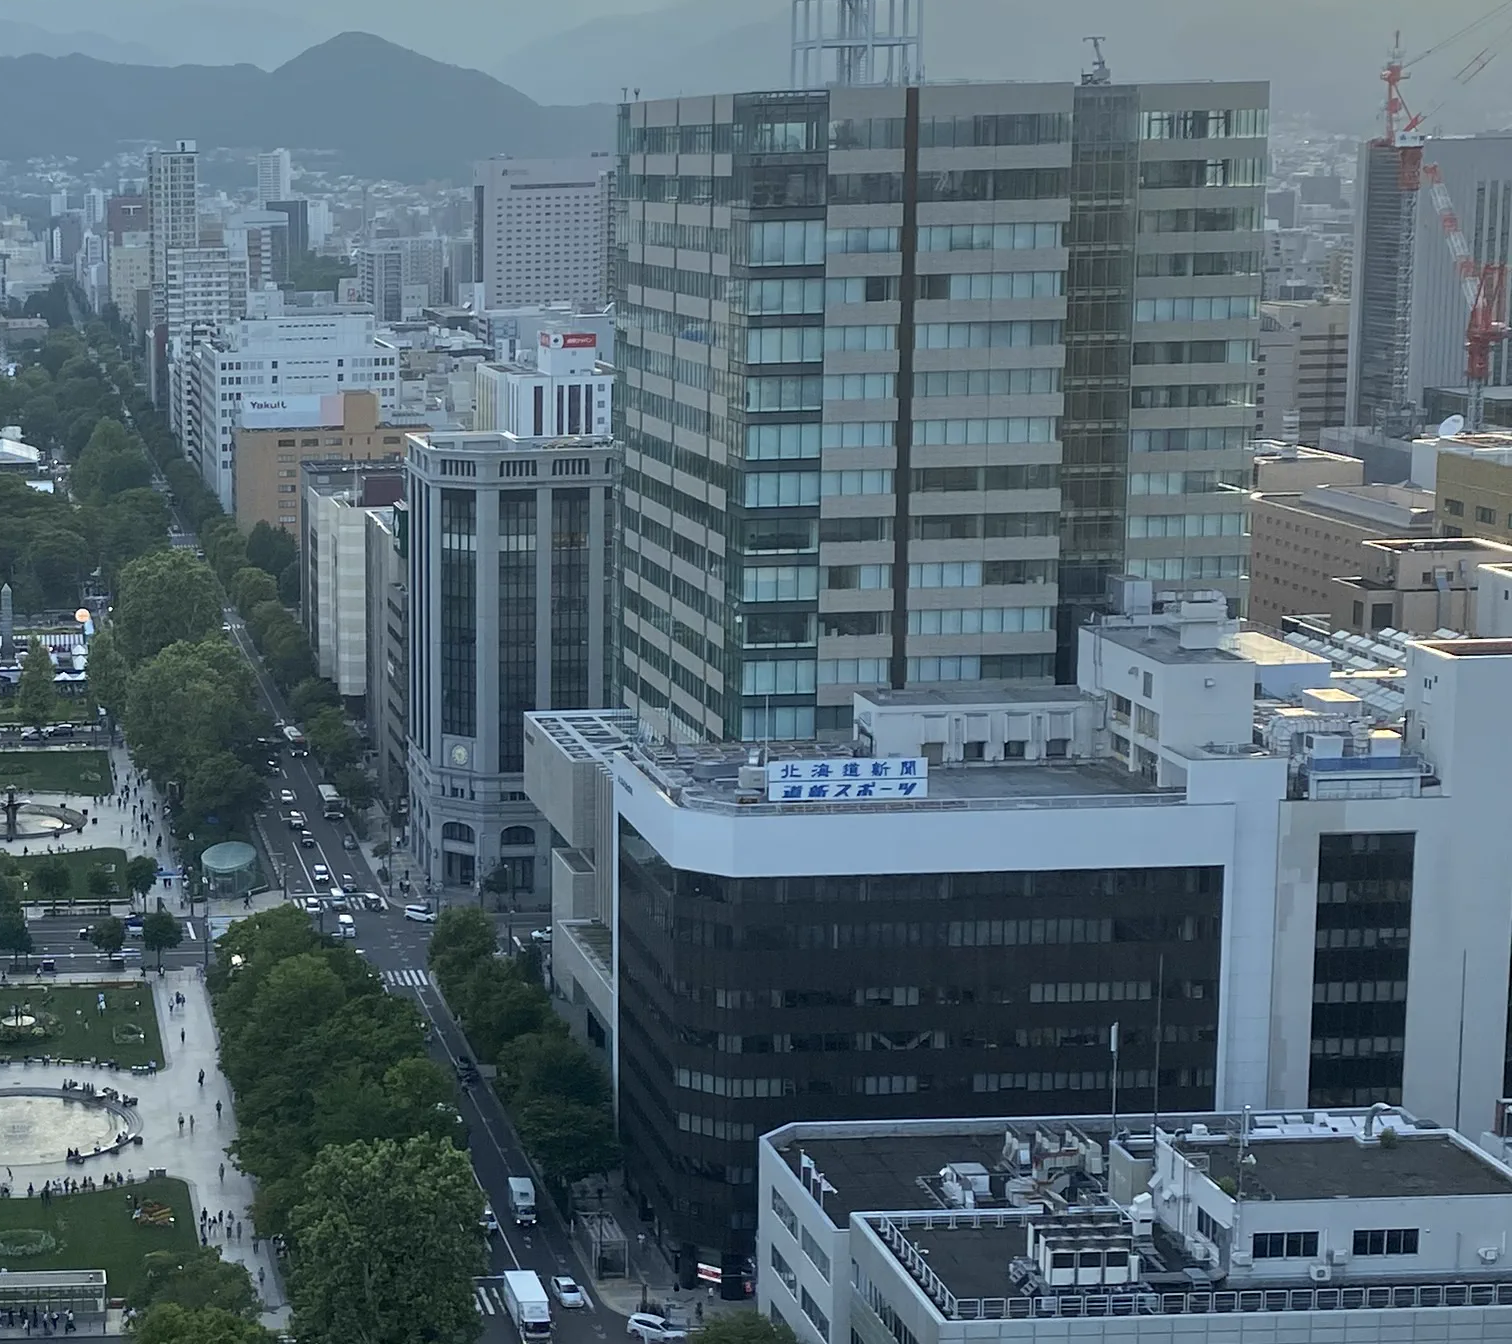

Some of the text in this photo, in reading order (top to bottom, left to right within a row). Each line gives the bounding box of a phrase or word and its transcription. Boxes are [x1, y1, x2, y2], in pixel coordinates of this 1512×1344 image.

[250, 401, 288, 409] Yakult
[781, 760, 917, 779] 北海道新聞
[782, 782, 917, 798] 道新スポーツ
